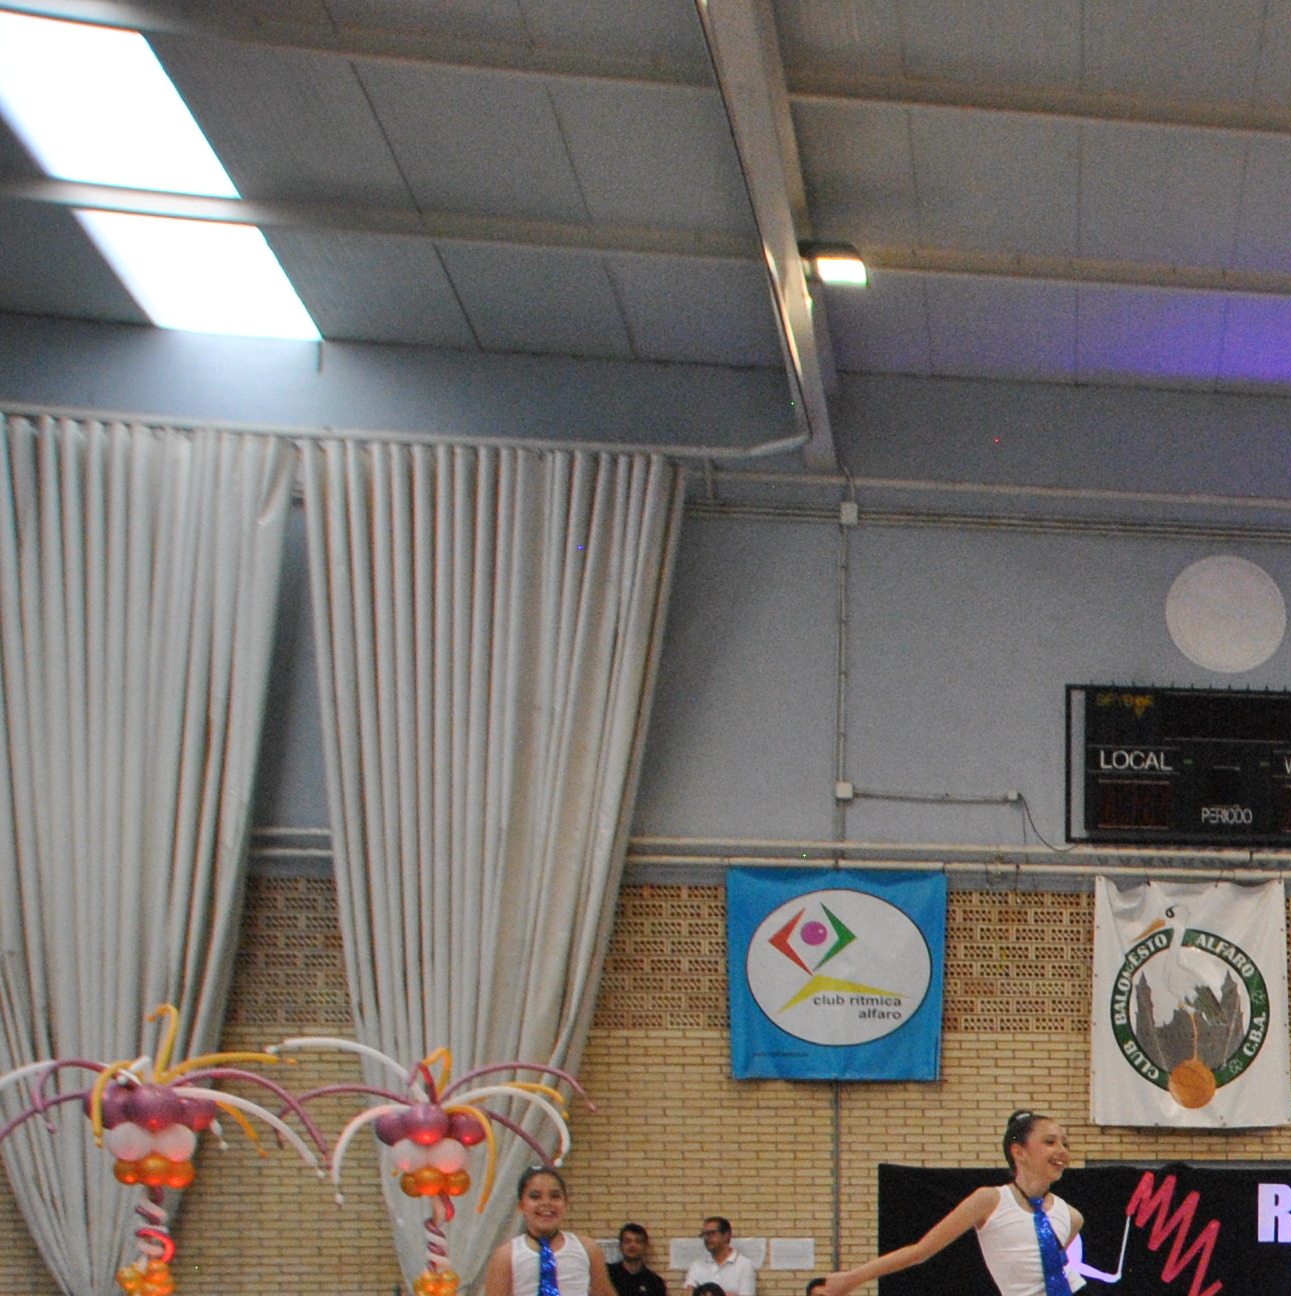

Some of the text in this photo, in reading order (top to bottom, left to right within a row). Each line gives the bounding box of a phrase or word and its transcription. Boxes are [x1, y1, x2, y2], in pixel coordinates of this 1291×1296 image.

[1100, 750, 1172, 771] LOCAL
[1201, 807, 1252, 823] PERIODO
[813, 995, 845, 1006] club
[1123, 1041, 1159, 1080] CLUB
[1196, 933, 1255, 978] ALFARO
[859, 1008, 901, 1020] alfaro
